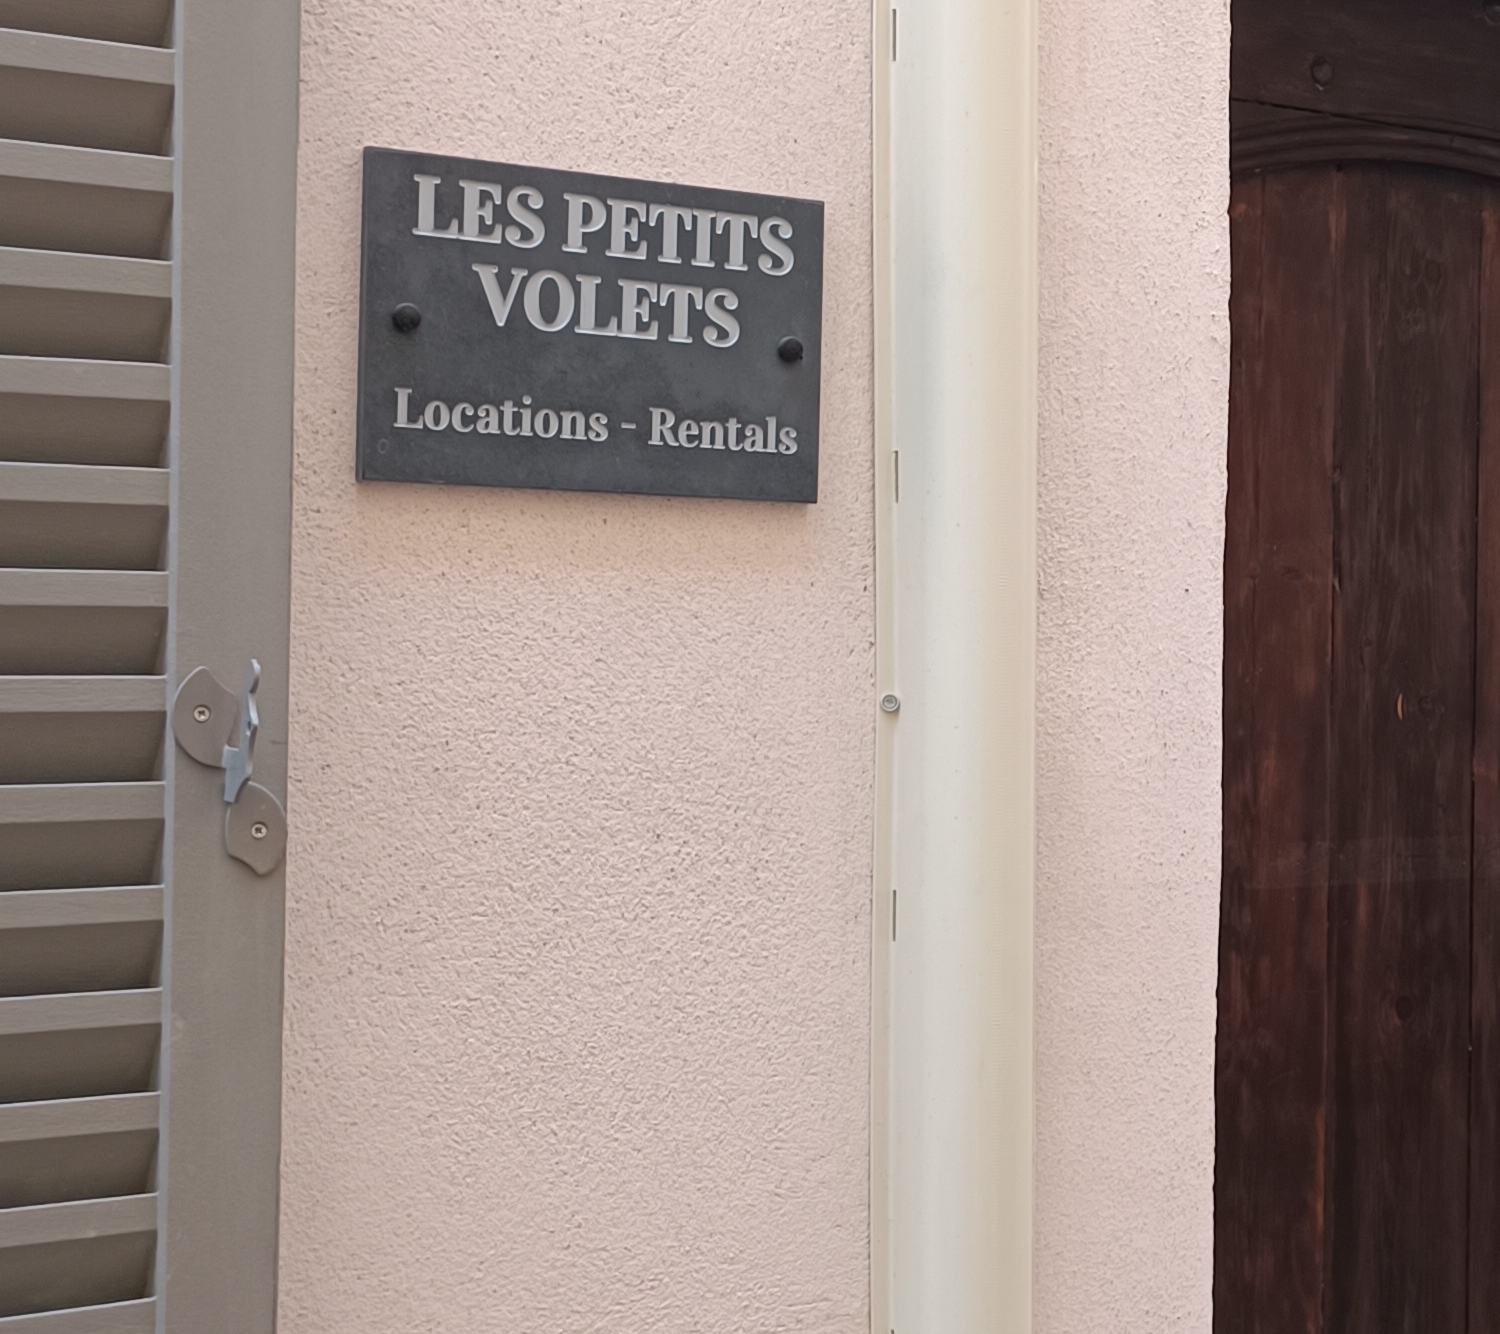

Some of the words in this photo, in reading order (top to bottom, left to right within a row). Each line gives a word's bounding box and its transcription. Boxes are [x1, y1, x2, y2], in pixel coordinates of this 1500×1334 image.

[412, 174, 545, 249] LES
[562, 192, 795, 276] PETITS
[471, 262, 741, 348] VOLETS
[393, 387, 609, 442] Locations
[648, 406, 798, 455] Rentals
